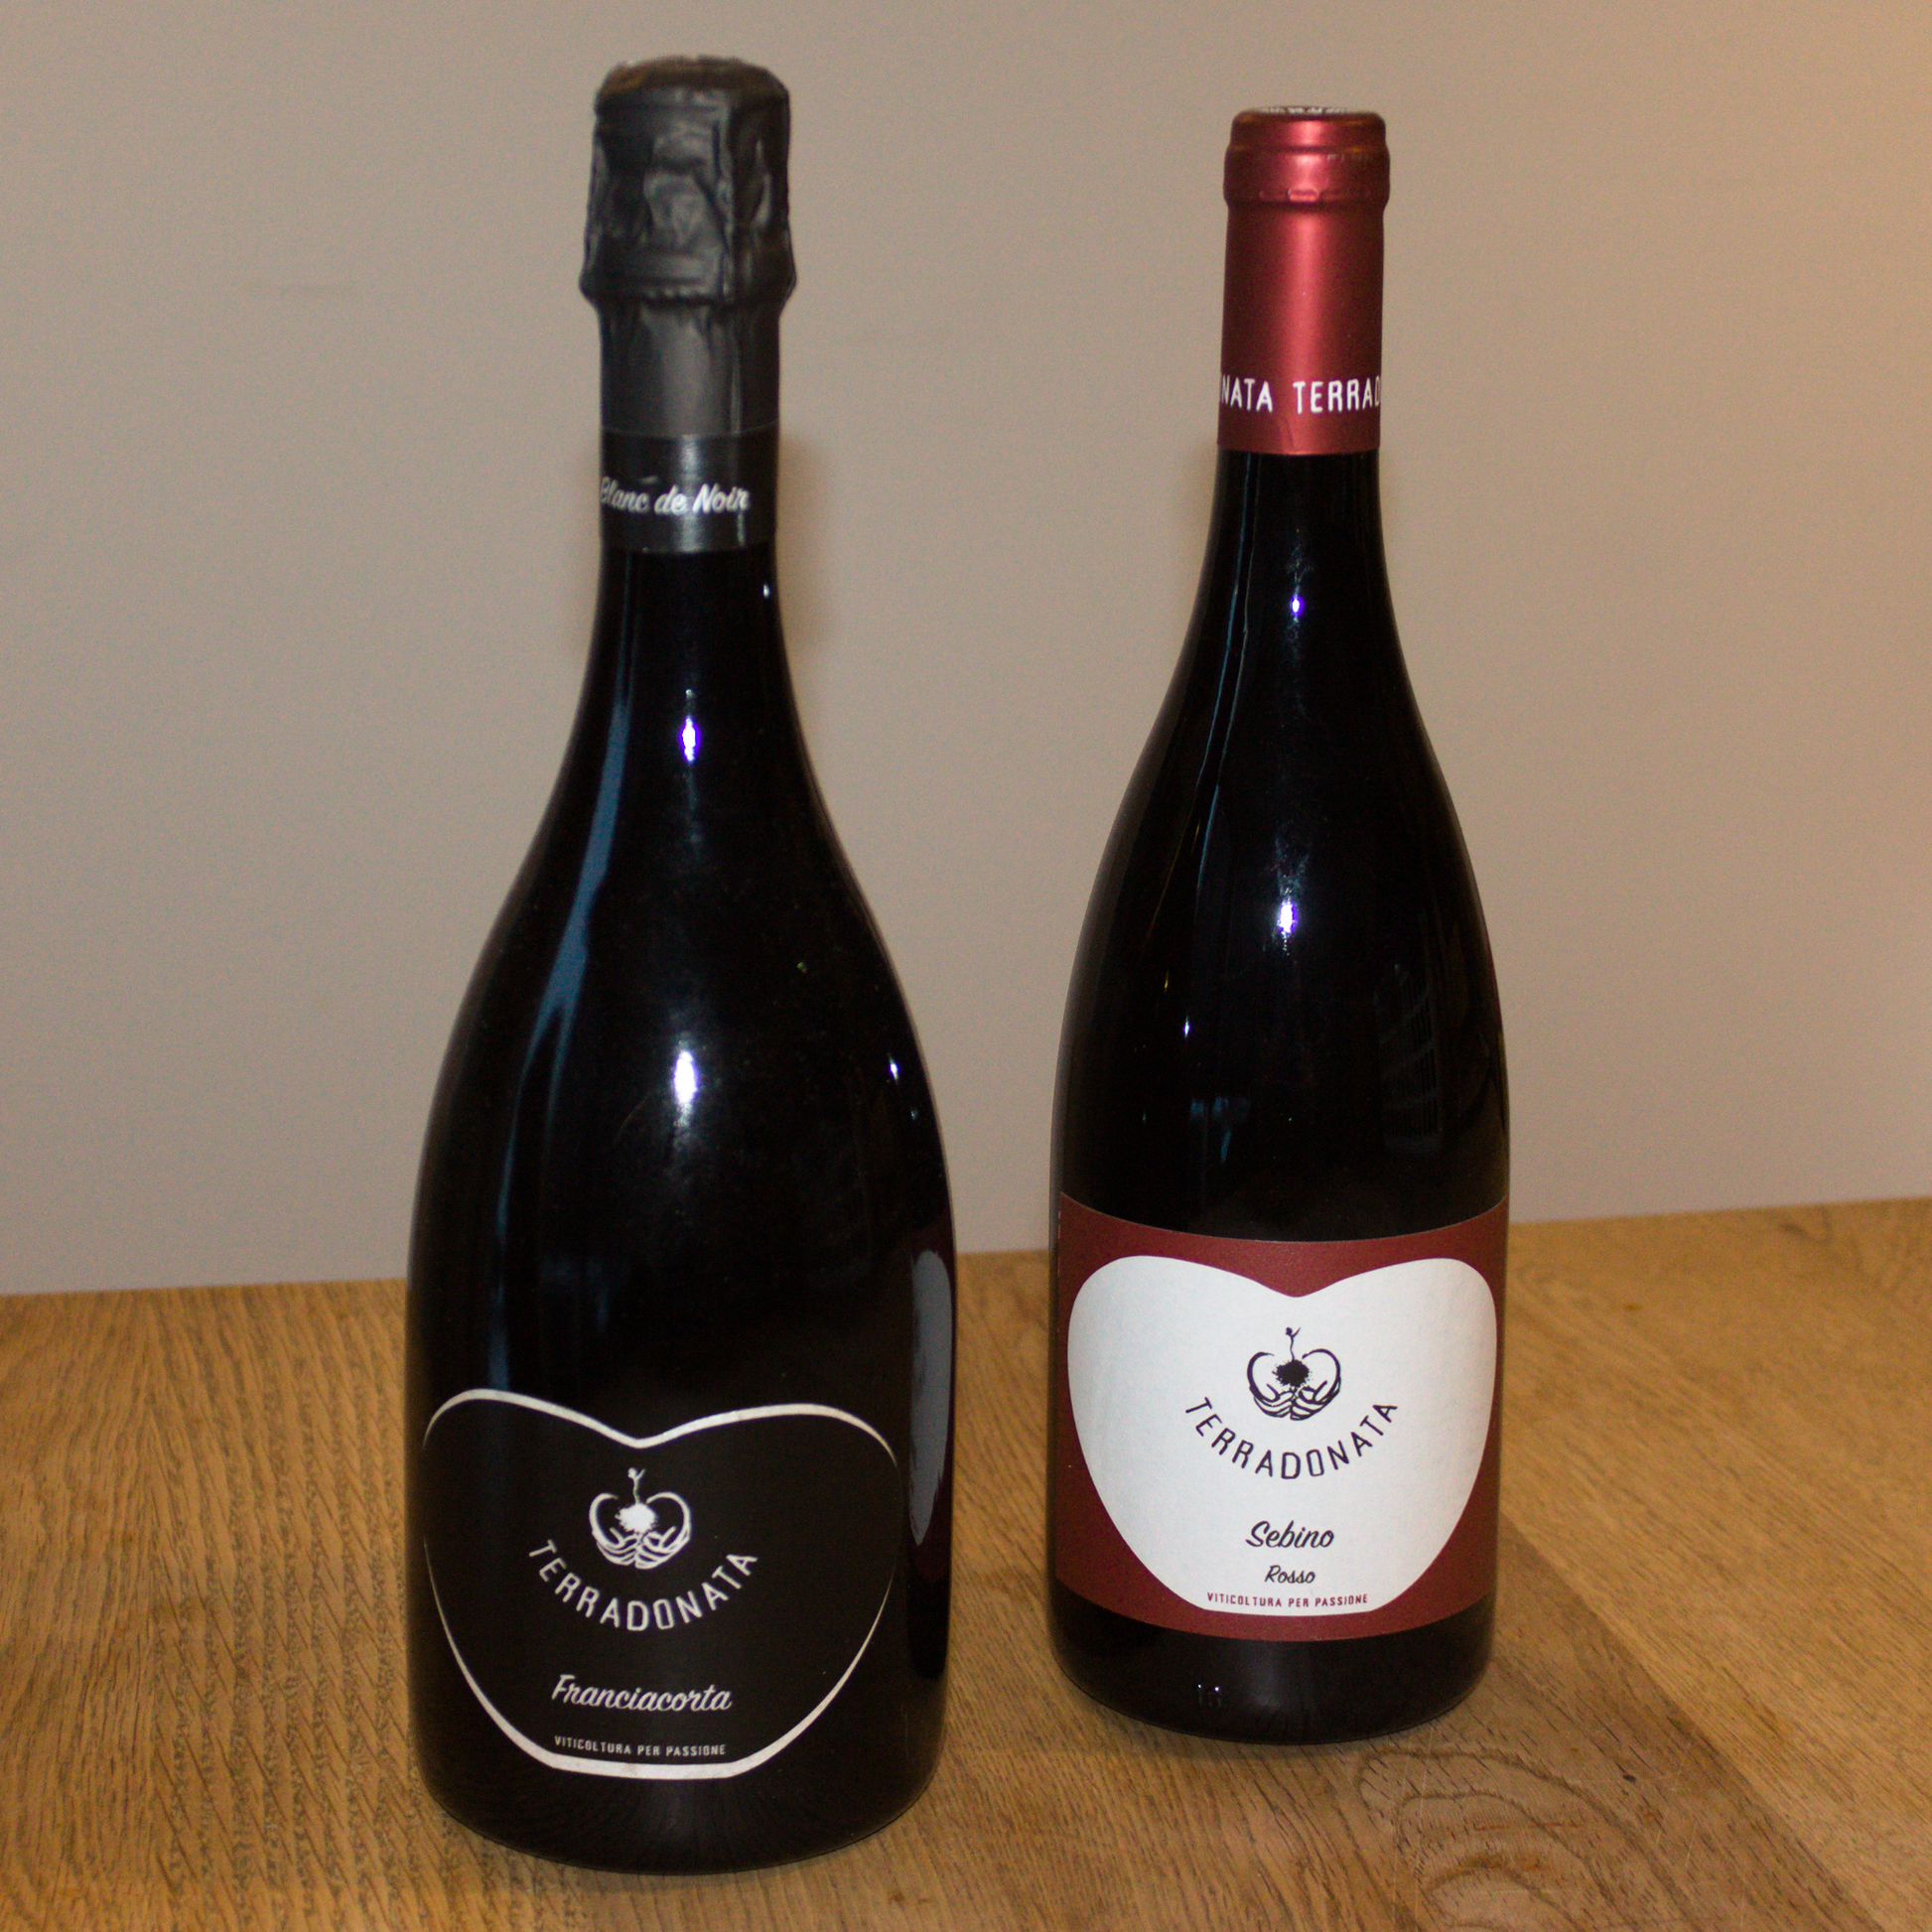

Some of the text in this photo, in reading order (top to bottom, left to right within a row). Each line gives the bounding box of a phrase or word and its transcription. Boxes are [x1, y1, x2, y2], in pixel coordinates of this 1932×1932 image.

[654, 484, 688, 515] de
[692, 483, 751, 514] Noir
[1184, 1396, 1398, 1480] TERRADONATA
[1245, 1520, 1334, 1549] Sebino
[528, 1539, 758, 1632] TERRADONATA
[1264, 1565, 1316, 1584] Rosso
[1206, 1591, 1369, 1608] VITICOLTURA PER PASSIONE
[552, 1674, 733, 1713] Franciacorta
[554, 1734, 727, 1757] VITICOLTURA PER PASSIONE
